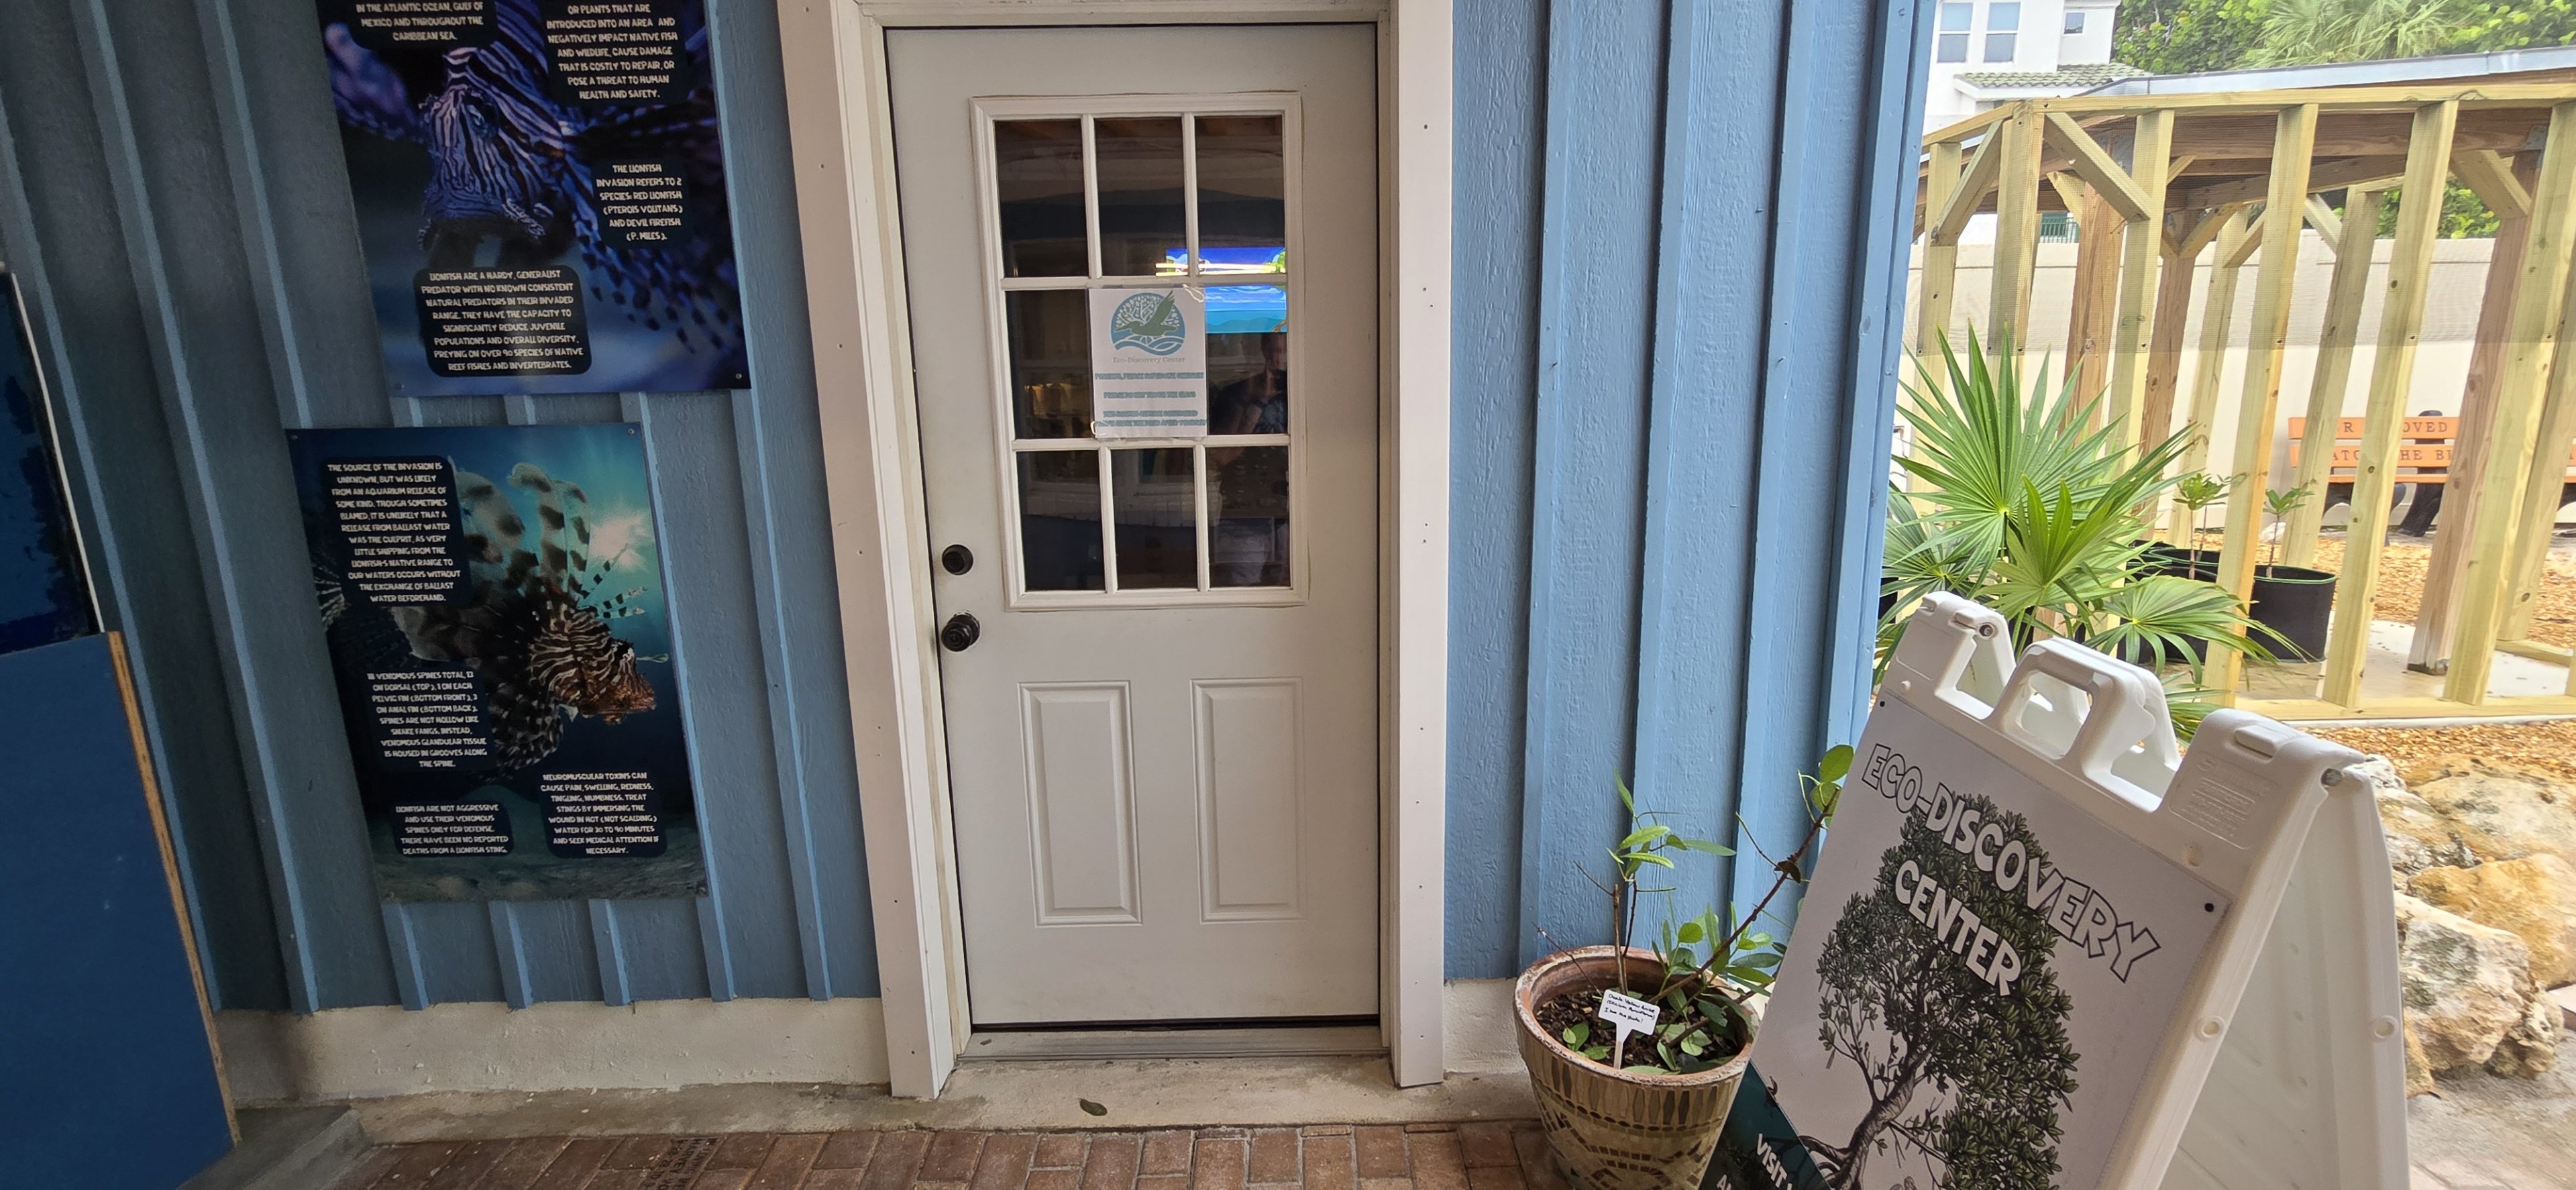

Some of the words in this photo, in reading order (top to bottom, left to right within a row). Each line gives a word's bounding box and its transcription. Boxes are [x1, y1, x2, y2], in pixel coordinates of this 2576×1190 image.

[356, 4, 364, 13] IN
[366, 4, 381, 13] THE
[384, 3, 421, 12] ATLANTIC
[453, 2, 471, 11] GULF
[474, 2, 483, 11] OF
[568, 6, 578, 14] OR
[580, 5, 610, 14] PLANTS
[612, 5, 632, 13] THAT
[635, 4, 651, 13] ARE
[361, 18, 391, 27] MEXICO
[394, 17, 410, 26] AND
[412, 17, 465, 26] THROUGHOUT
[468, 16, 483, 25] THE
[547, 19, 596, 29] INTRODUCED
[598, 19, 616, 28] INTO
[618, 19, 629, 28] AN
[632, 18, 652, 27] AREA
[658, 18, 675, 26] AND
[393, 32, 437, 41] CARIBBEAN
[547, 34, 596, 43] NEGATIVELY
[598, 34, 627, 42] IMPACT
[629, 32, 659, 42] NATIVE
[661, 32, 678, 41] FISH
[557, 49, 574, 57] AND
[612, 48, 637, 56] CAUSE
[639, 47, 673, 56] DAMAGE
[559, 62, 579, 71] THAT
[580, 62, 588, 71] IS
[589, 62, 618, 70] COSTLY
[621, 62, 630, 70] TO
[663, 61, 675, 69] OR
[568, 76, 587, 85] POSE
[590, 76, 594, 85] A
[596, 76, 626, 85] THREAT
[628, 76, 638, 84] TO
[639, 75, 669, 84] HUMAN
[580, 91, 608, 99] HEALTH
[610, 90, 627, 99] AND
[628, 90, 660, 99] SAFETY.
[612, 165, 627, 173] THE
[629, 164, 662, 172] LIONFISH
[596, 178, 634, 187] INVASION
[635, 178, 663, 186] REFERS
[665, 178, 675, 186] TO
[677, 178, 682, 186] 2
[633, 192, 647, 200] RED
[649, 191, 682, 199] LIONFISH
[609, 219, 625, 227] AND
[626, 219, 647, 227] DEVIL
[649, 218, 681, 226] FIREFISH
[429, 272, 462, 280] LIONFISH
[464, 272, 478, 280] ARE
[480, 272, 484, 280] A
[517, 270, 560, 279] GENERALIST
[421, 285, 460, 294] PREDATOR
[462, 285, 482, 293] WITH
[484, 284, 494, 292] NO
[496, 284, 526, 292] KNOWN
[528, 283, 573, 292] CONSISTENT
[426, 298, 460, 307] NATURAL
[463, 297, 506, 306] PREDATORS
[506, 297, 515, 305] IN
[517, 296, 537, 305] THEIR
[539, 296, 574, 305] INVADED
[462, 311, 480, 319] THEY
[483, 311, 504, 319] HAVE
[506, 310, 521, 318] THE
[521, 309, 559, 318] CAPACITY
[561, 309, 571, 317] TO
[443, 323, 496, 332] SIGNIFICANTLY
[499, 323, 528, 331] REDUCE
[530, 323, 566, 331] JUVENILE
[434, 337, 484, 345] POPULATIONS
[487, 336, 502, 345] AND
[504, 336, 535, 344] OVERALL
[434, 349, 466, 358] PREYING
[468, 349, 478, 358] ON
[481, 349, 500, 358] OVER
[503, 349, 513, 357] 90
[514, 348, 543, 357] SPECIES
[544, 348, 553, 356] OF
[554, 347, 584, 356] NATIVE
[1113, 356, 1161, 364] Eco-Discovery
[1163, 356, 1185, 364] Center
[449, 362, 464, 371] REEF
[467, 362, 490, 370] FISHES
[493, 362, 508, 370] AND
[2400, 449, 2422, 460] HE
[343, 464, 371, 472] SOURCE
[365, 571, 394, 579] WATERS
[396, 570, 425, 578] OCCURS
[1862, 743, 2161, 983] ECO-DISCOVERY
[1894, 859, 2022, 996] CENTER
[1756, 1133, 1788, 1189] VISIT
